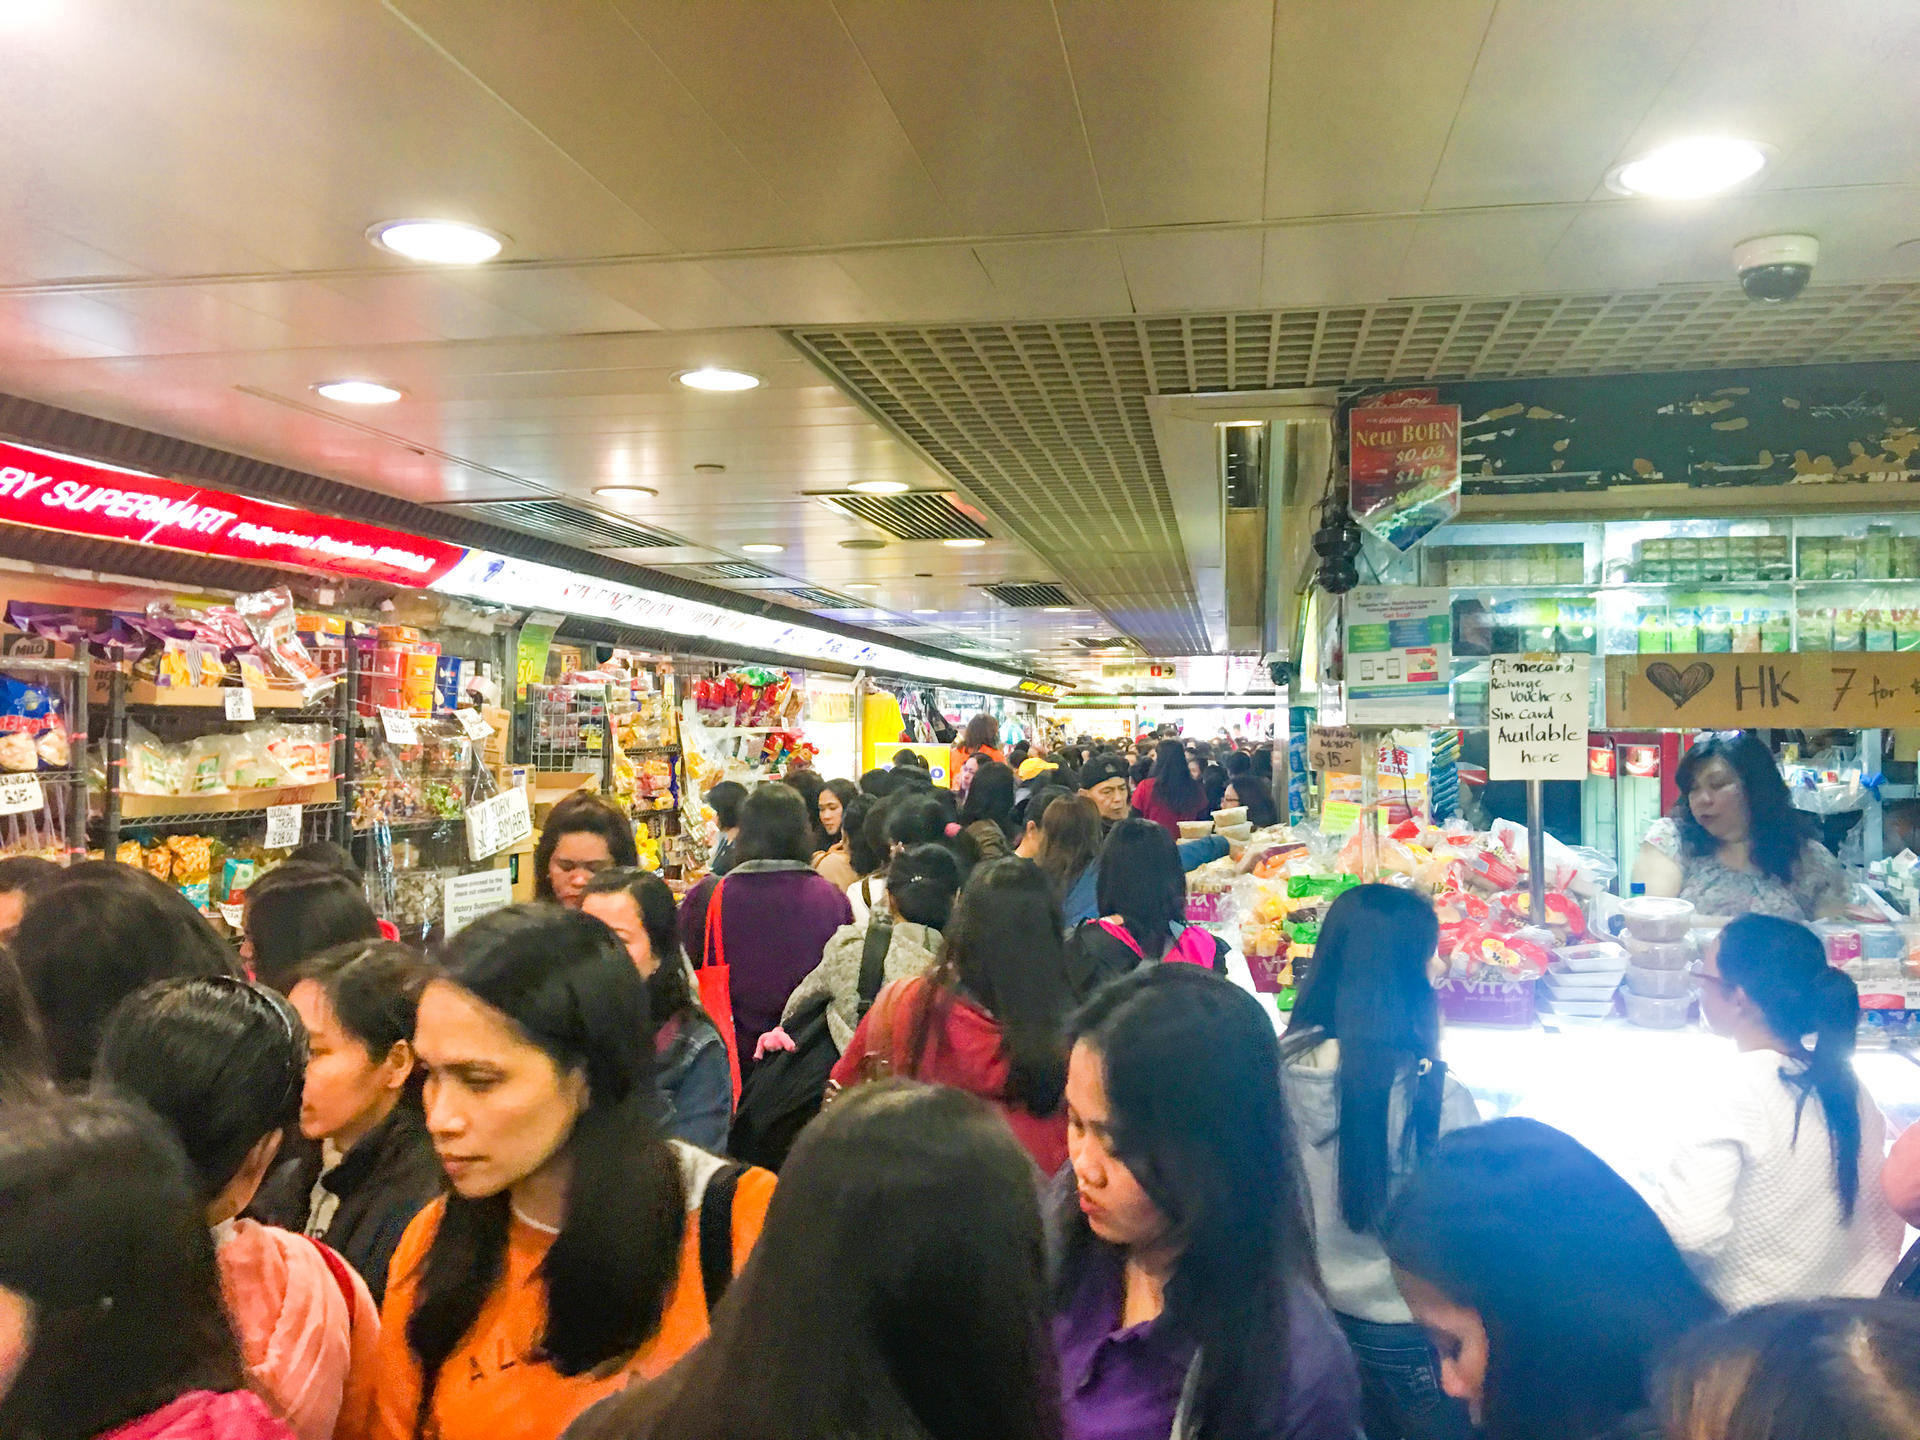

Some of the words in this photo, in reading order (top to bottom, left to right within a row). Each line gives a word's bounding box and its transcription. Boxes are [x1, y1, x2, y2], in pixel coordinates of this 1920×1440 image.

[1402, 421, 1454, 443] BORN
[41, 480, 238, 534] SUPERMART
[1491, 678, 1544, 691] Recharge
[1735, 664, 1799, 711] HK
[1831, 667, 1857, 711] 7
[1868, 675, 1900, 709] for
[1491, 707, 1516, 720] Sim
[1521, 749, 1560, 764] here
[453, 904, 473, 913] Victory
